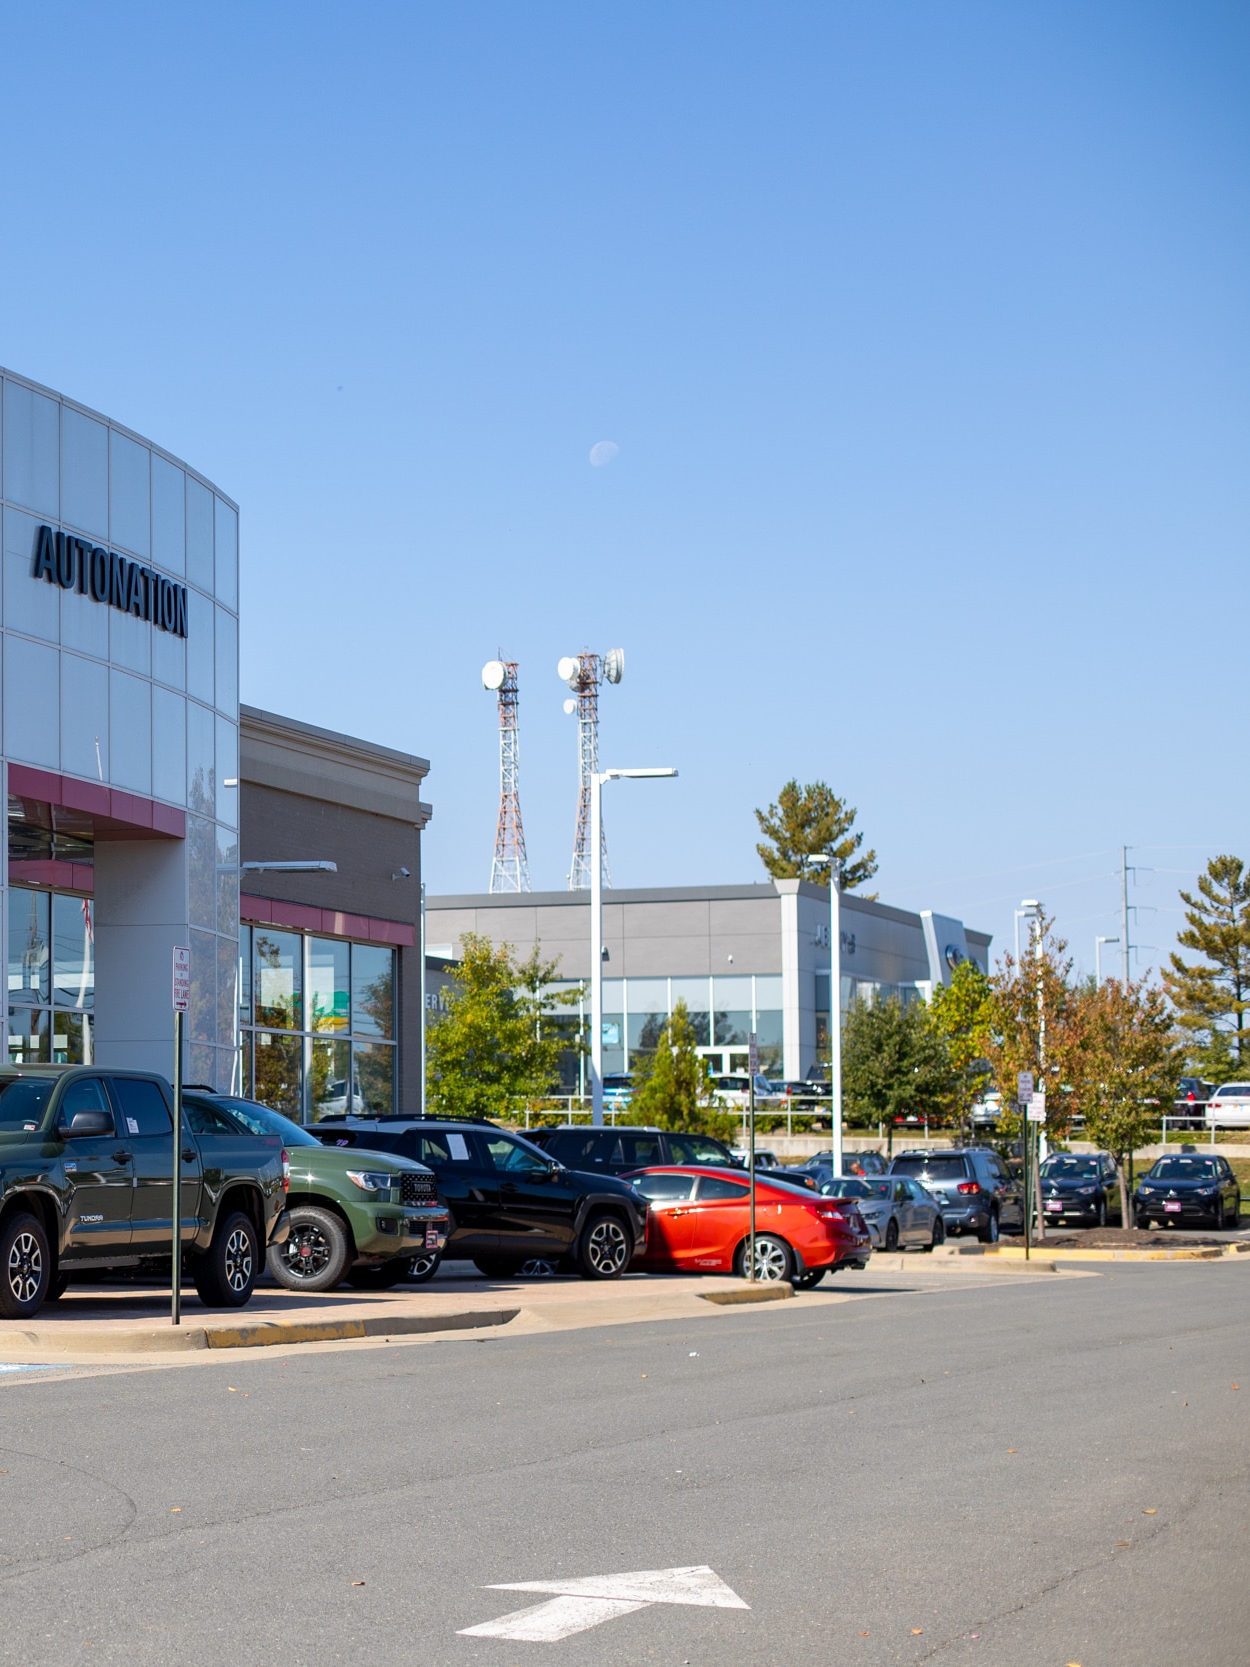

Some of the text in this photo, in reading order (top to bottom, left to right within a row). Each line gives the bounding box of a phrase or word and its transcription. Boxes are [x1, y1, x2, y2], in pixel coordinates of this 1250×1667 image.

[35, 525, 188, 638] AUTONATION
[414, 1183, 432, 1192] TOYOTA
[80, 1214, 104, 1222] TUNDRA
